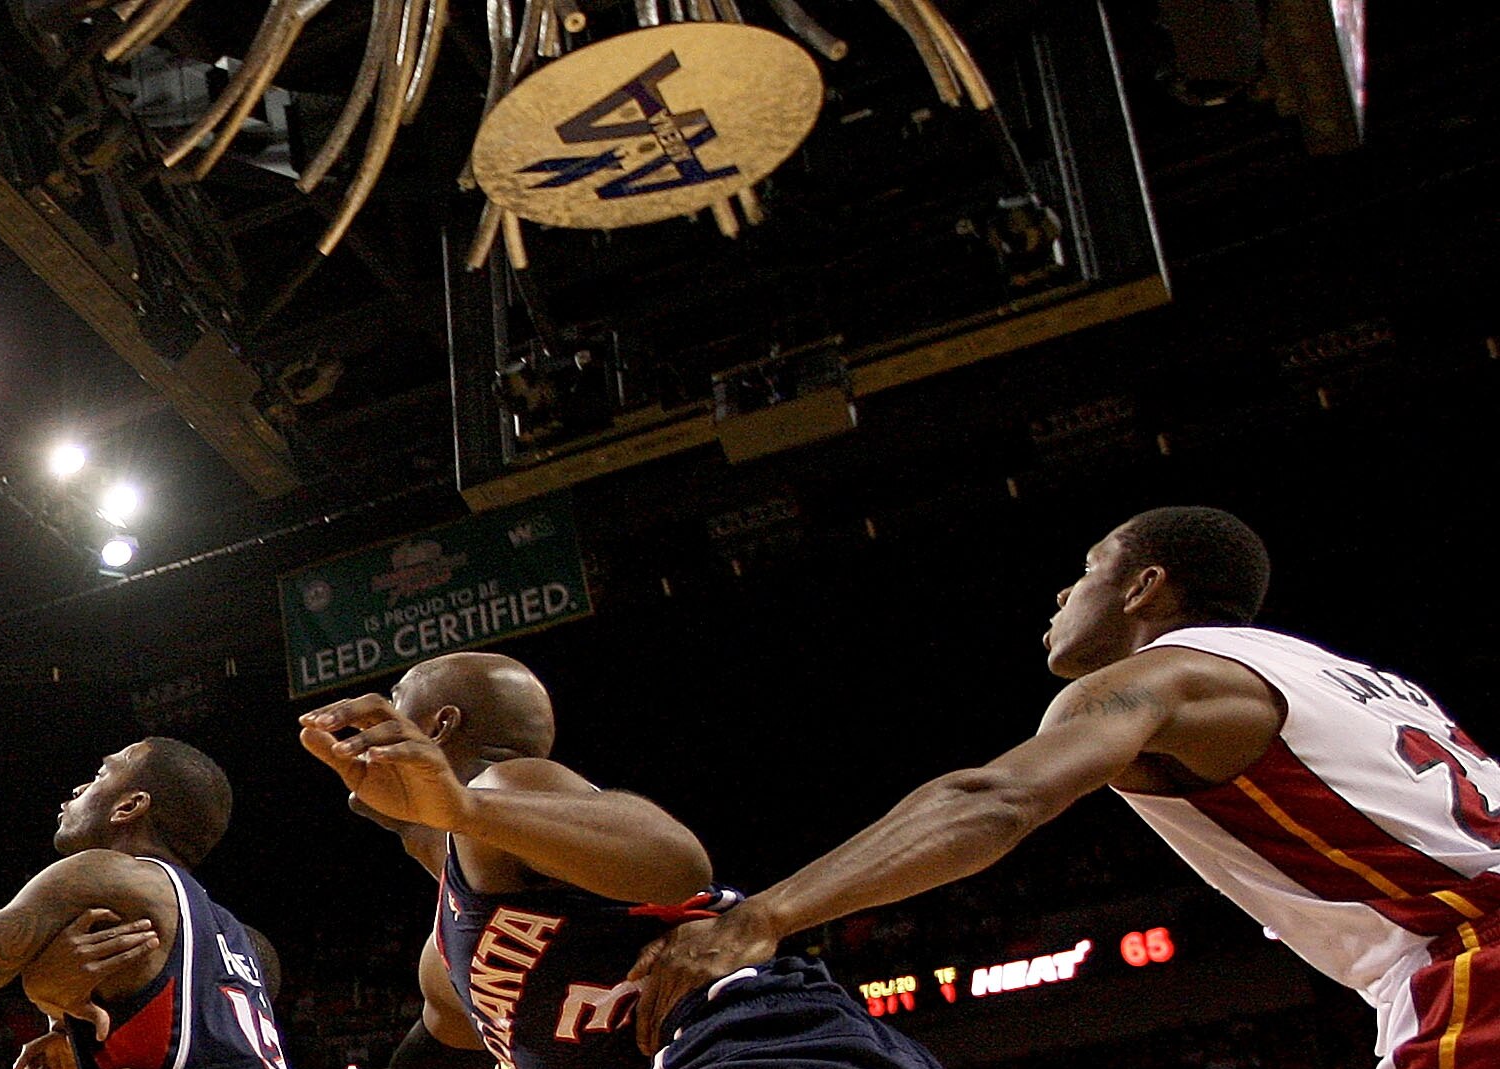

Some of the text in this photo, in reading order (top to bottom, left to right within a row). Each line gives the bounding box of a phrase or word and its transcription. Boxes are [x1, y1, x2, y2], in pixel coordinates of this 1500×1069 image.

[300, 638, 381, 687] LEED
[394, 581, 579, 658] CERTIFIED.
[384, 598, 445, 626] PROUD
[449, 588, 473, 608] TO
[1394, 722, 1500, 850] 2
[971, 939, 1093, 997] HEAT
